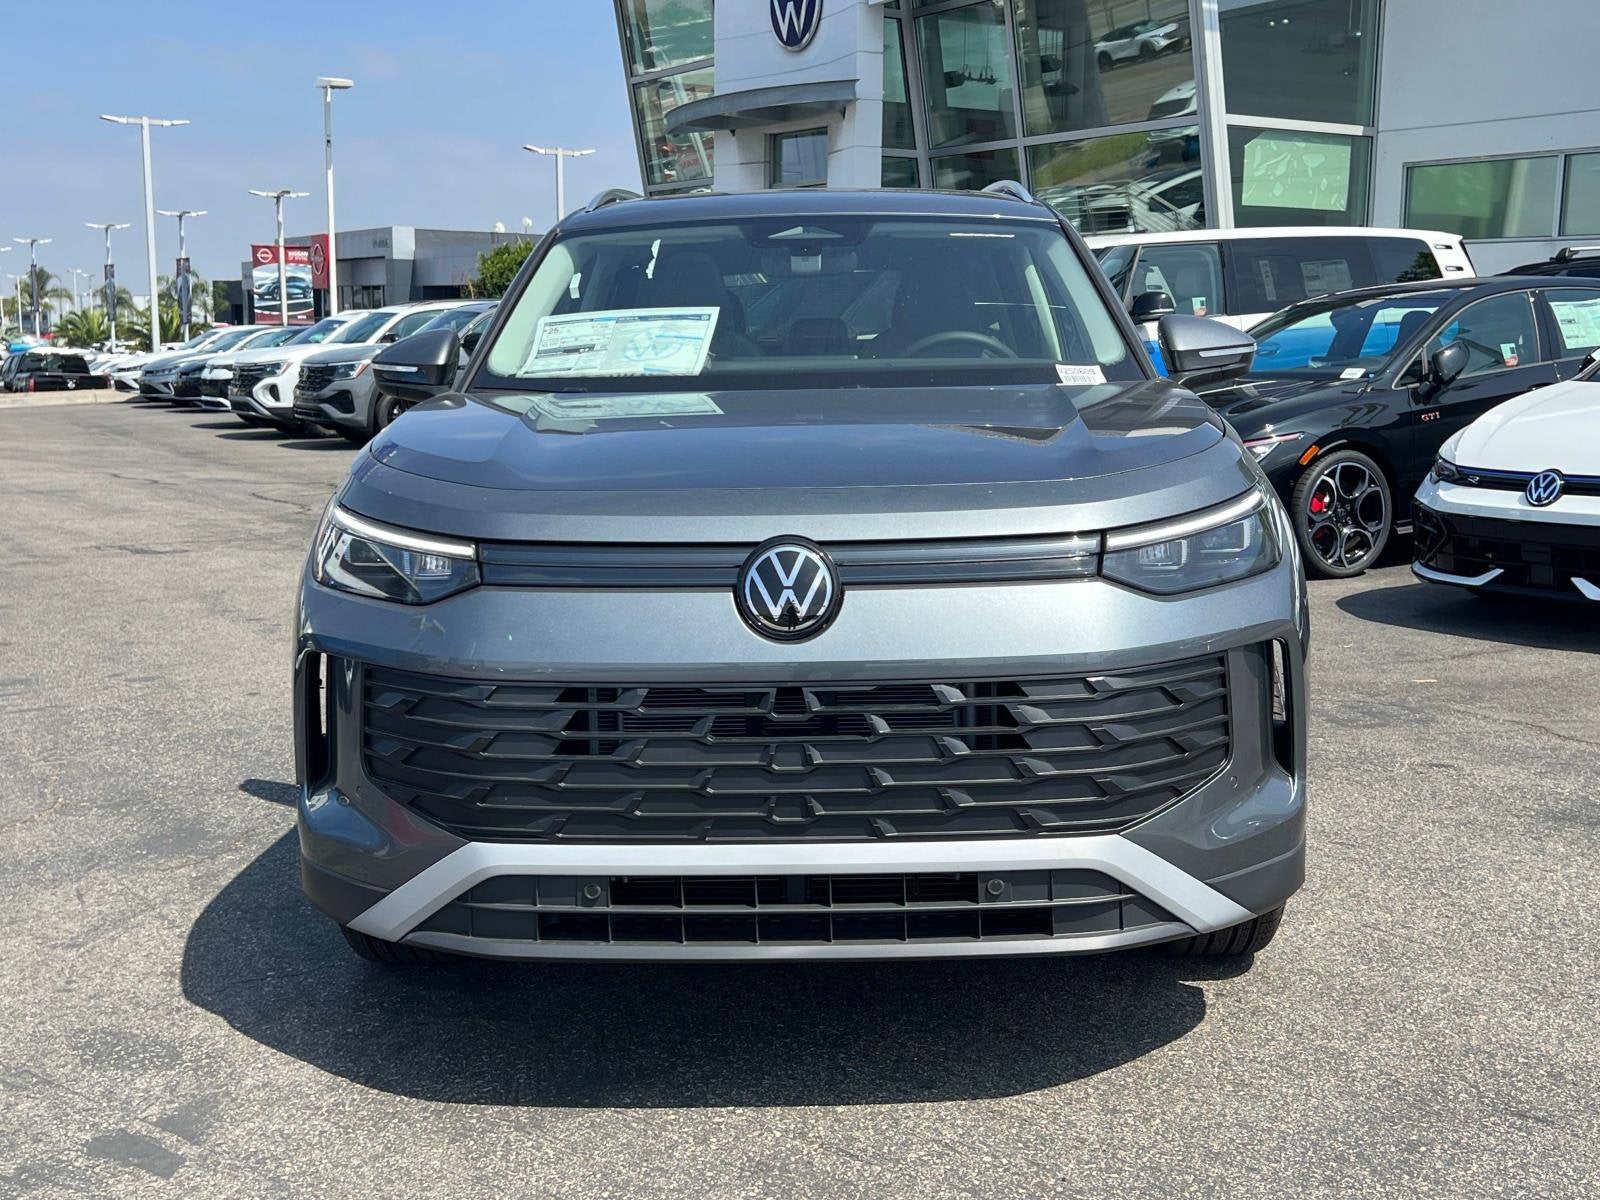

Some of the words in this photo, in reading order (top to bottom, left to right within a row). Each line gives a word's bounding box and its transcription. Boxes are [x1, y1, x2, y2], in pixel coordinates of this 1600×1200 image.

[1421, 411, 1441, 421] GTI
[1529, 472, 1559, 502] VW
[748, 547, 829, 624] VW
